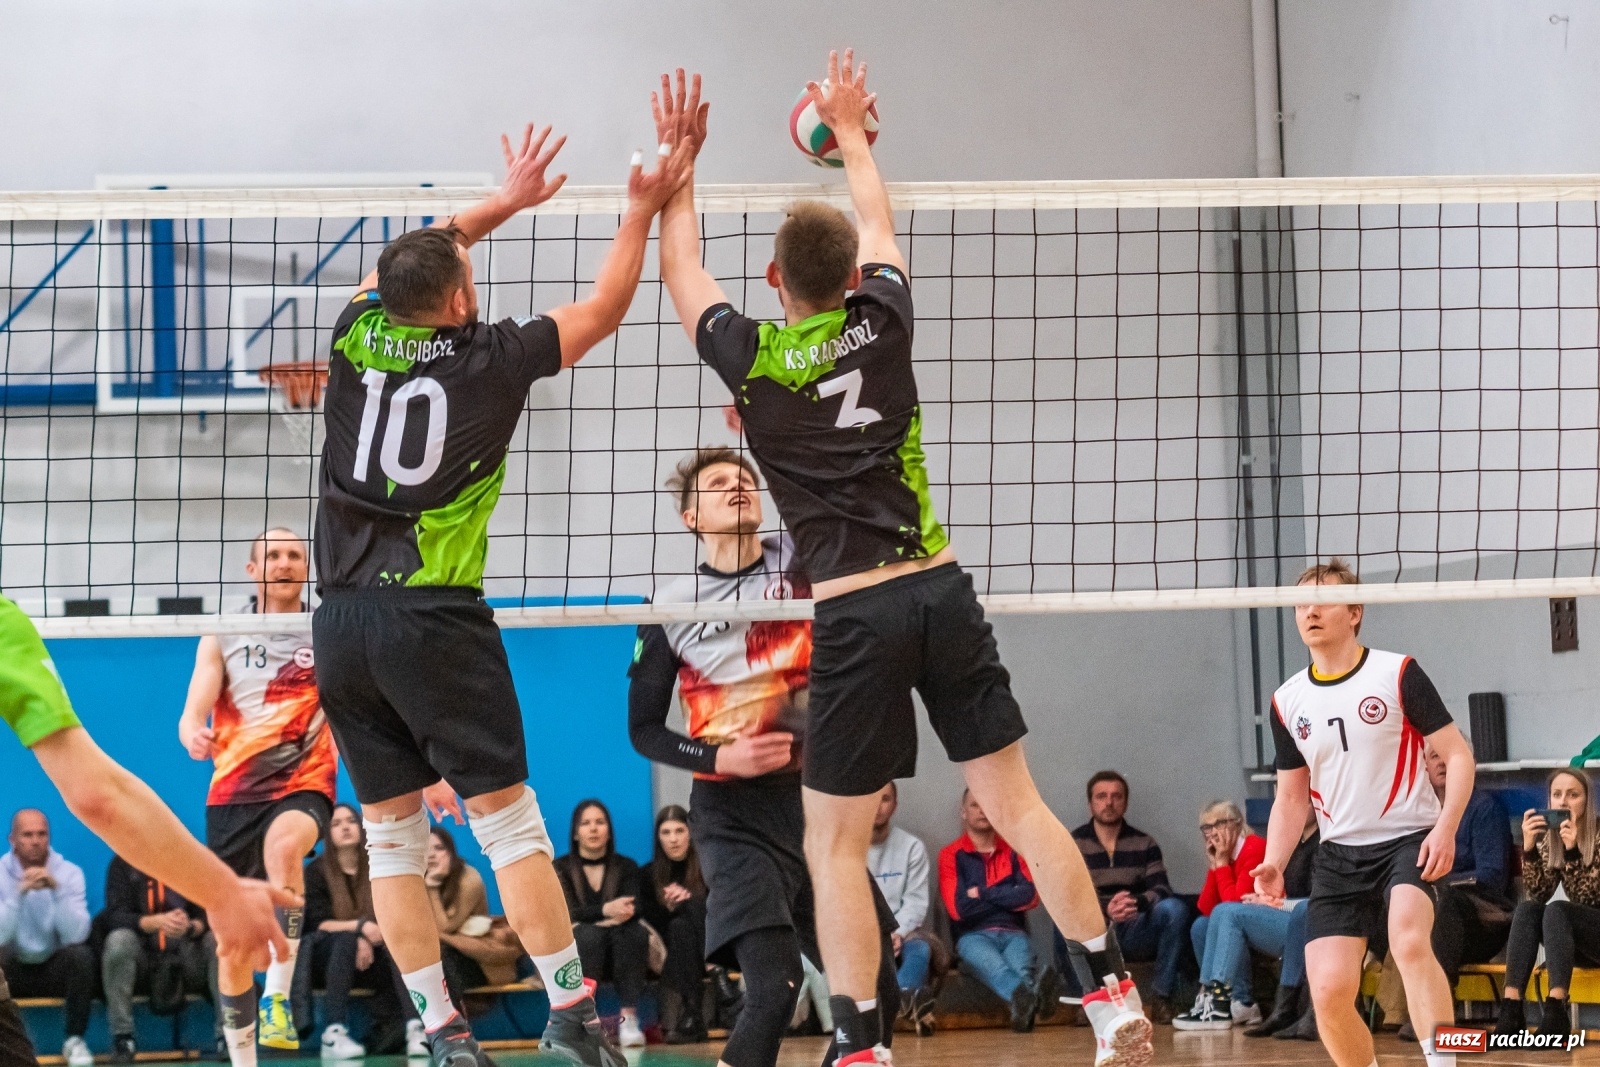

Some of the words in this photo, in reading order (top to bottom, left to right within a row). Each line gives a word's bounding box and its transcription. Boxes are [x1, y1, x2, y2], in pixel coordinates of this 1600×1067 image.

[784, 348, 807, 370] KS
[353, 367, 448, 486] 10
[243, 644, 267, 669] 13
[1327, 717, 1349, 752] 7
